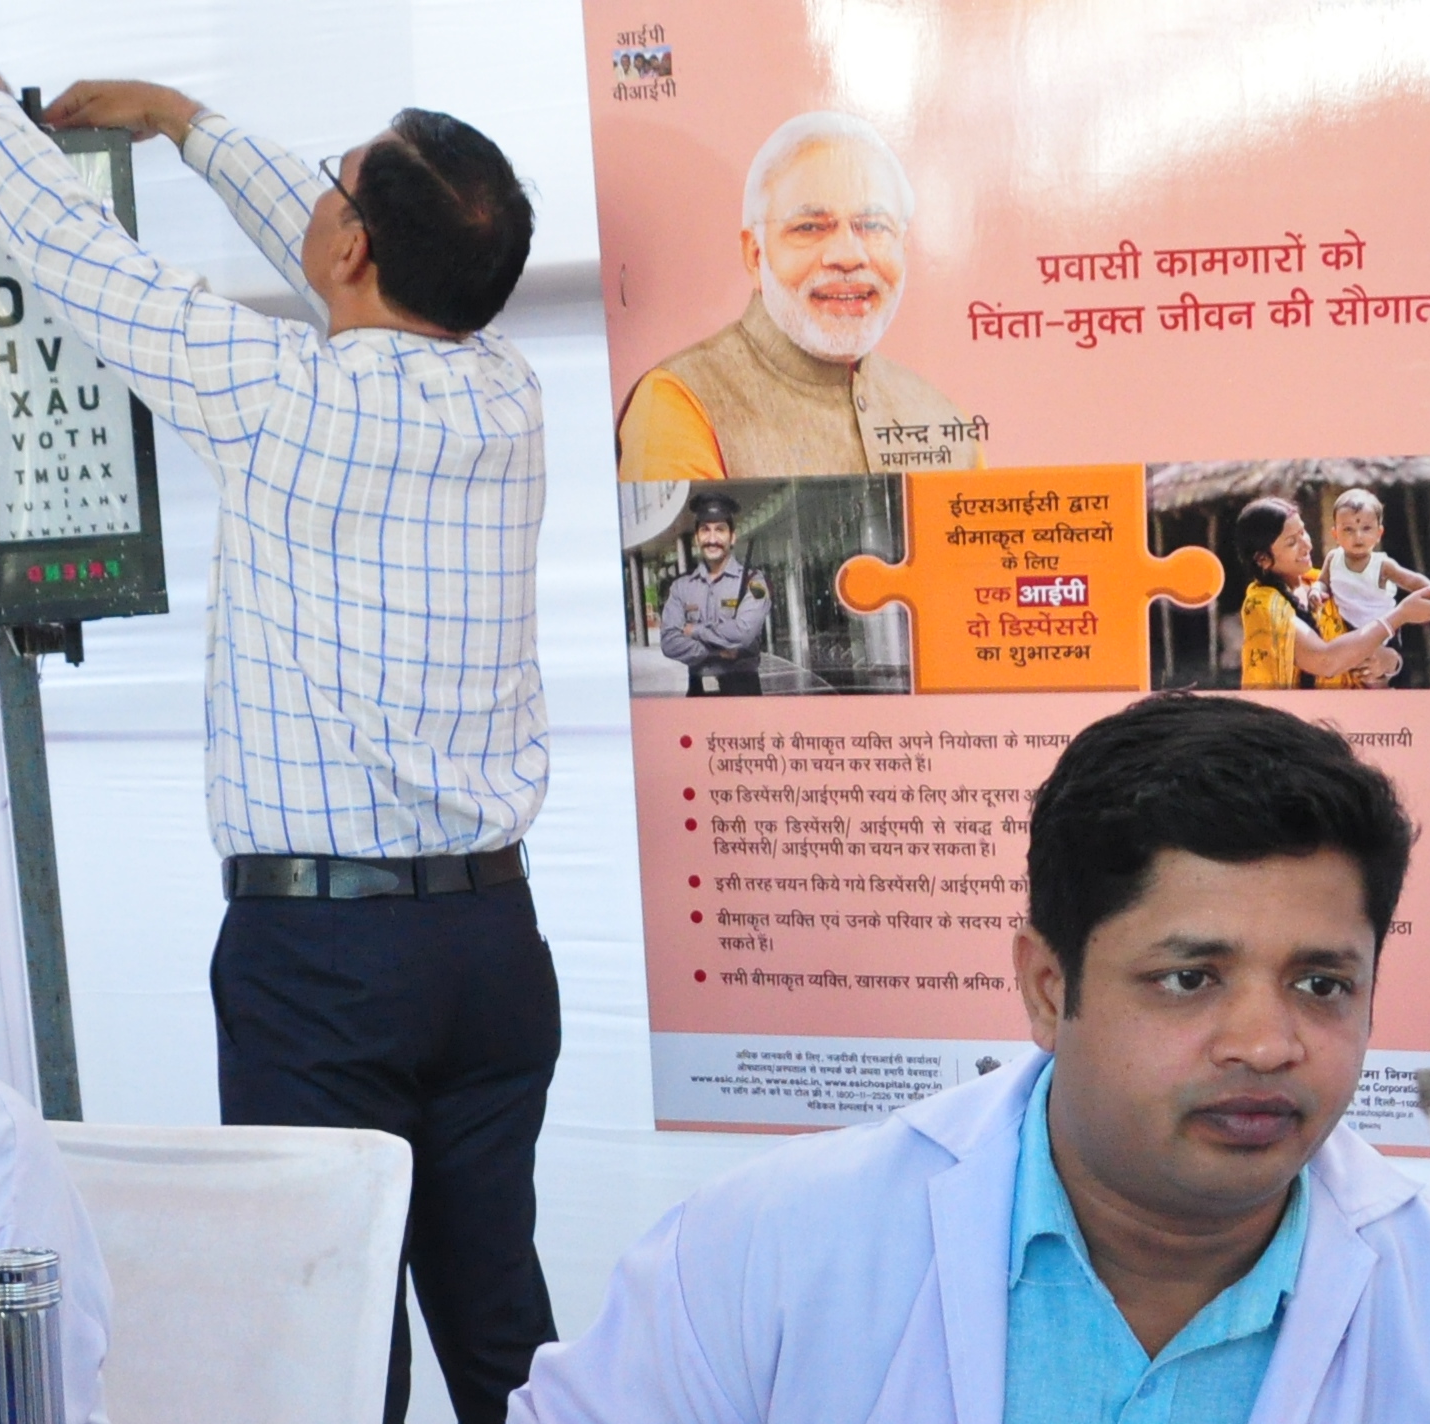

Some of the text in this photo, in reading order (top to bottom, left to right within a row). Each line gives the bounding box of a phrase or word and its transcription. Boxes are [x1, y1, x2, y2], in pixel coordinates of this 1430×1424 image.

[1036, 228, 1367, 285] प्रवासी कामगारों को
[1156, 291, 1256, 333] जीवन
[1268, 287, 1314, 328] की
[873, 414, 990, 445] नरेन्द्र मोदी
[879, 445, 952, 466] प्रधानमंत्री
[948, 490, 1109, 518] ईएसआईसी द्वारा
[945, 520, 1114, 550] बीमाकृत व्यक्तियों
[1001, 551, 1059, 570] के लिए
[974, 576, 1086, 606] एक आईपी
[966, 610, 1099, 638] दो डिस्पेंसरी
[975, 644, 1091, 667] का शुभारम्भ
[706, 731, 765, 753] ईएसआई
[772, 731, 785, 750] के
[851, 731, 892, 750] व्यक्ति
[898, 730, 933, 749] अपने
[939, 730, 998, 749] नियोक्ता
[1003, 730, 1019, 749] के
[790, 758, 807, 772] का
[811, 758, 844, 772] चयन
[848, 758, 871, 772] कर
[875, 753, 912, 772] सकते
[709, 789, 733, 806] एक
[867, 785, 897, 802] स्वयं
[900, 785, 915, 802] के
[919, 784, 947, 805] लिए
[951, 784, 977, 802] और
[981, 789, 1020, 808] दूसरा
[711, 815, 747, 834] किसी
[754, 820, 777, 836] एक
[860, 815, 923, 837] आईएमपी
[932, 815, 945, 834] से
[782, 837, 844, 858] आईएमपी
[847, 842, 866, 856] का
[869, 842, 903, 856] चयन
[906, 842, 930, 856] कर
[932, 842, 976, 856] सकता
[714, 872, 741, 892] इसी
[744, 877, 772, 892] तरह
[775, 877, 808, 892] चयन
[811, 873, 840, 892] किये
[844, 874, 865, 892] गये
[940, 873, 1005, 895] आईएमपी
[775, 909, 815, 927] व्यक्ति
[820, 910, 840, 930] एवं
[845, 910, 881, 928] उनके
[886, 910, 933, 929] परिवार
[937, 911, 952, 929] के
[956, 916, 1002, 930] सदस्य
[718, 933, 755, 951] सकते
[720, 967, 748, 986] सभी
[855, 975, 909, 990] खासकर
[915, 971, 959, 990] प्रवासी
